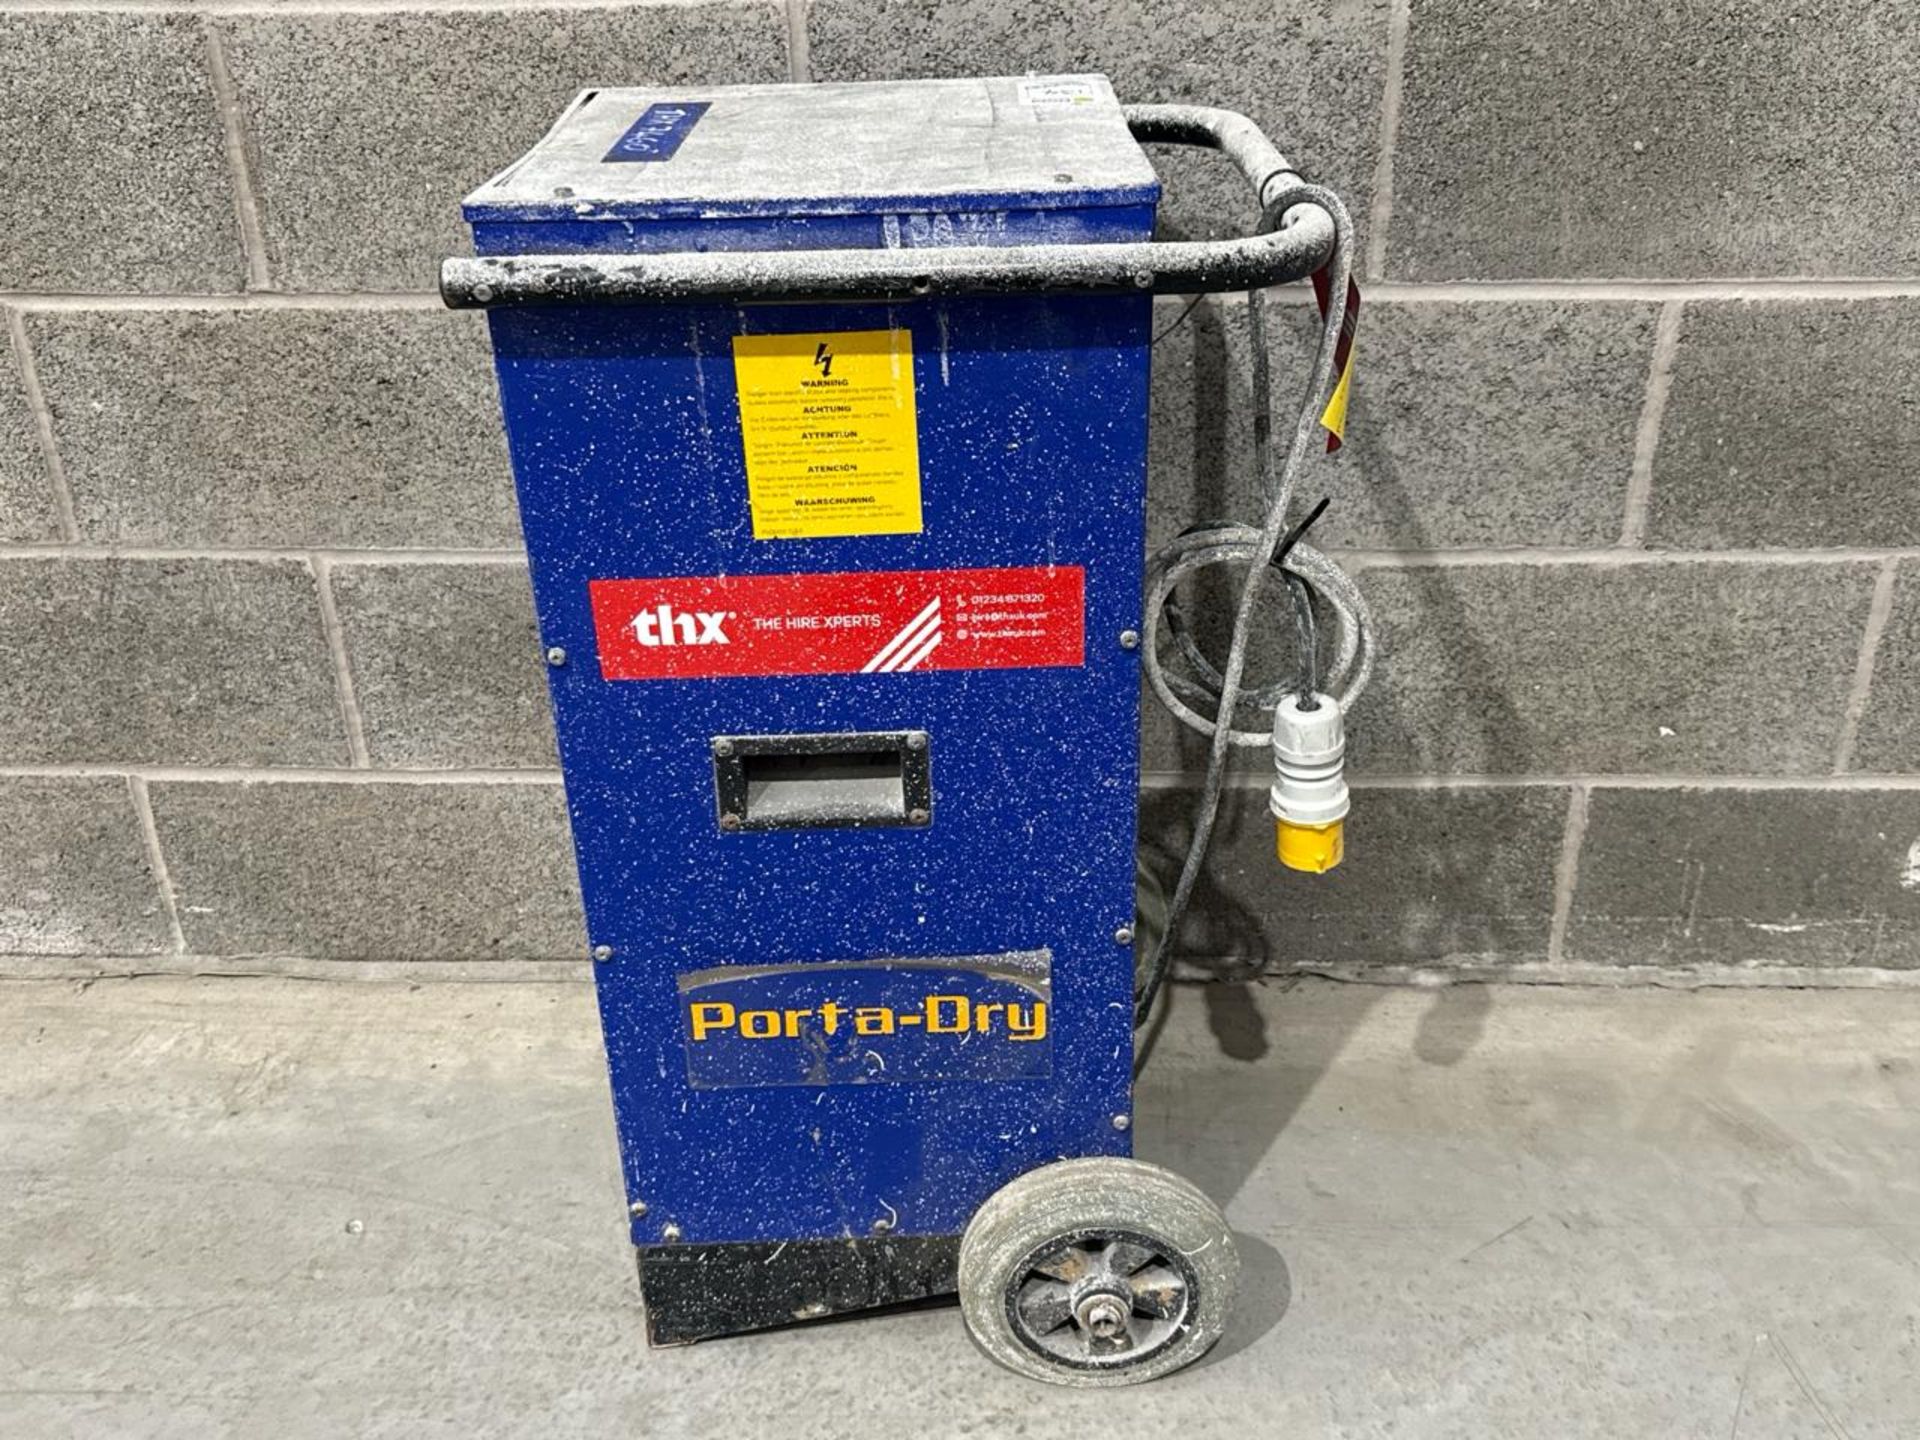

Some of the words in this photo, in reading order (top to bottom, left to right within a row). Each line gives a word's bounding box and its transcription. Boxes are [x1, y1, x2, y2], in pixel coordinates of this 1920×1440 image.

[800, 379, 849, 388] WARNING
[803, 405, 852, 414] ACHTUNG
[801, 430, 858, 440] ATTENTION
[807, 464, 858, 473] ATENCIÓN
[794, 496, 876, 507] WAARSCHUWING
[752, 617, 782, 630] THE
[786, 615, 821, 629] HIRE
[823, 613, 882, 628] XPERTS
[689, 994, 1048, 1041] Porta-Dry
